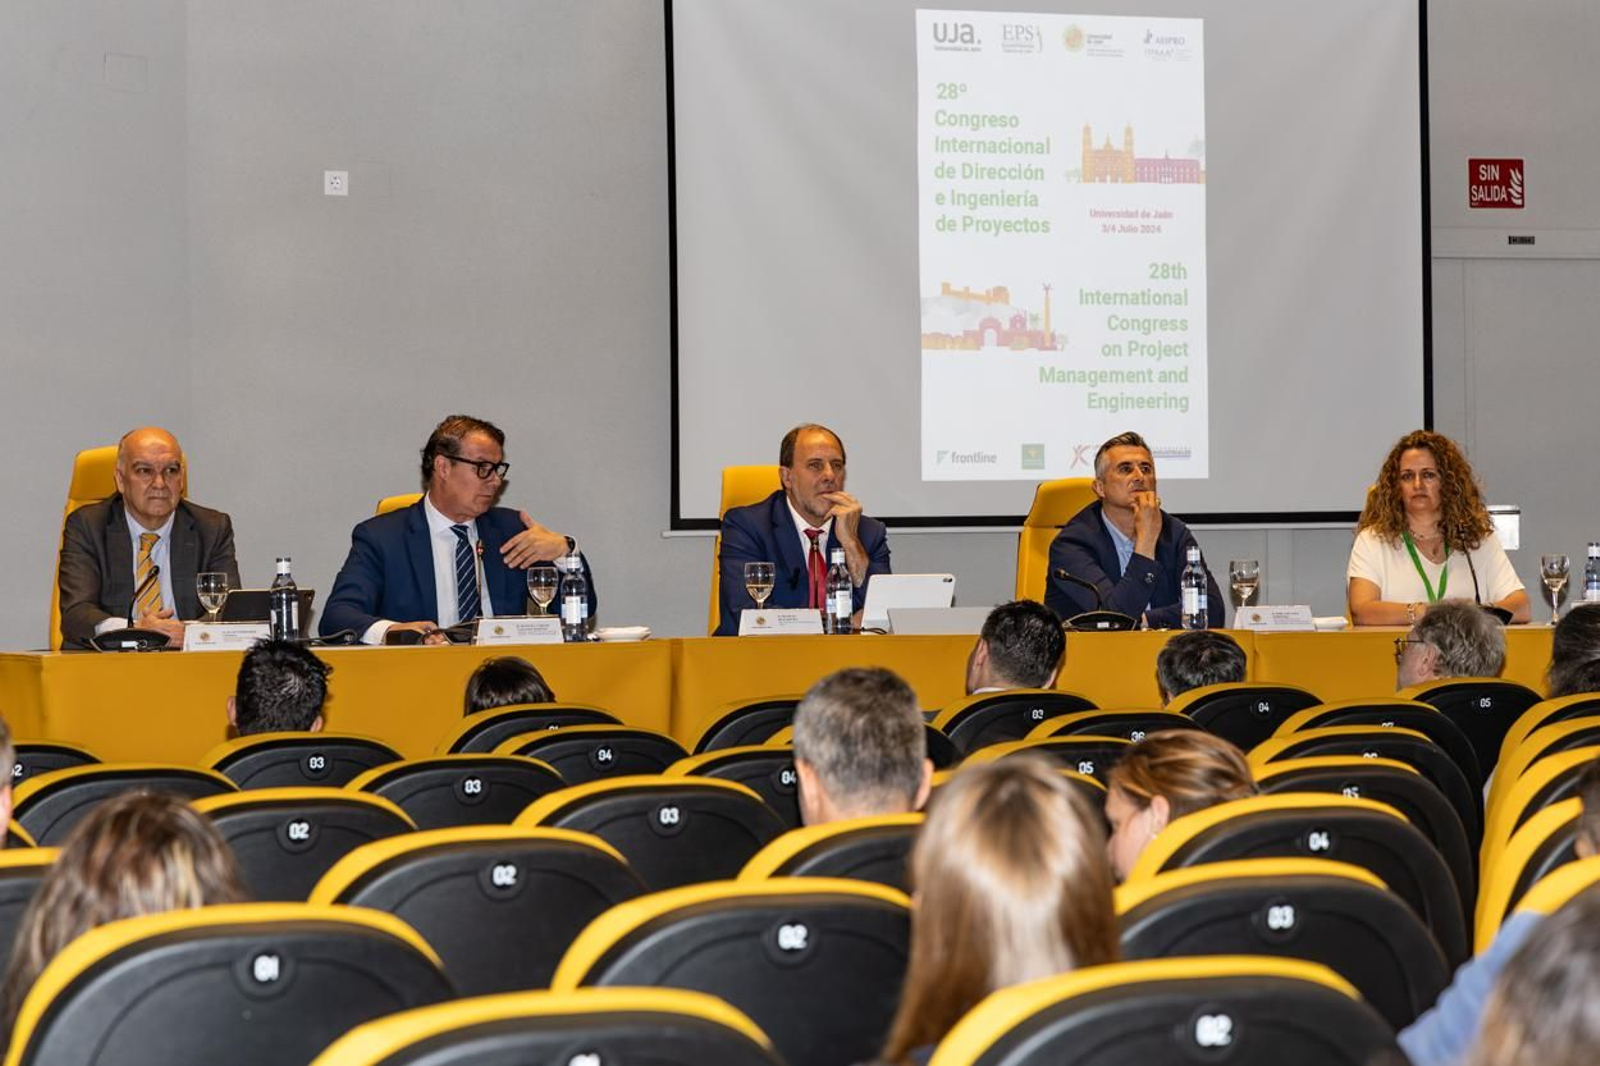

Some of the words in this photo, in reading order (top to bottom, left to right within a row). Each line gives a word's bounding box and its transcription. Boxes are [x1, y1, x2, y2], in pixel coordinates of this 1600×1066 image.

[1002, 24, 1034, 41] EPS
[934, 109, 1020, 132] Congreso
[934, 135, 1051, 154] Internacional
[934, 161, 956, 179] de
[961, 162, 1045, 181] Dirección
[1479, 164, 1500, 181] SIN
[935, 191, 946, 205] e
[951, 189, 1039, 210] Ingeniería
[1471, 184, 1508, 201] SALIDA
[1090, 208, 1139, 219] Universidad
[1141, 208, 1151, 219] de
[935, 214, 957, 232] de
[962, 215, 1051, 237] Proyectos
[1149, 262, 1188, 280] 28th
[1079, 287, 1188, 306] International
[1107, 314, 1188, 336] Congress
[1101, 343, 1122, 357] on
[1128, 340, 1189, 361] Project
[1038, 366, 1153, 387] Management
[1158, 366, 1188, 383] and
[1087, 391, 1189, 413] Engineering
[951, 450, 998, 465] frontline
[310, 756, 324, 769] 03
[598, 749, 612, 761] 04
[1078, 761, 1094, 775] 05
[464, 779, 481, 793] 03
[289, 822, 309, 840] 02
